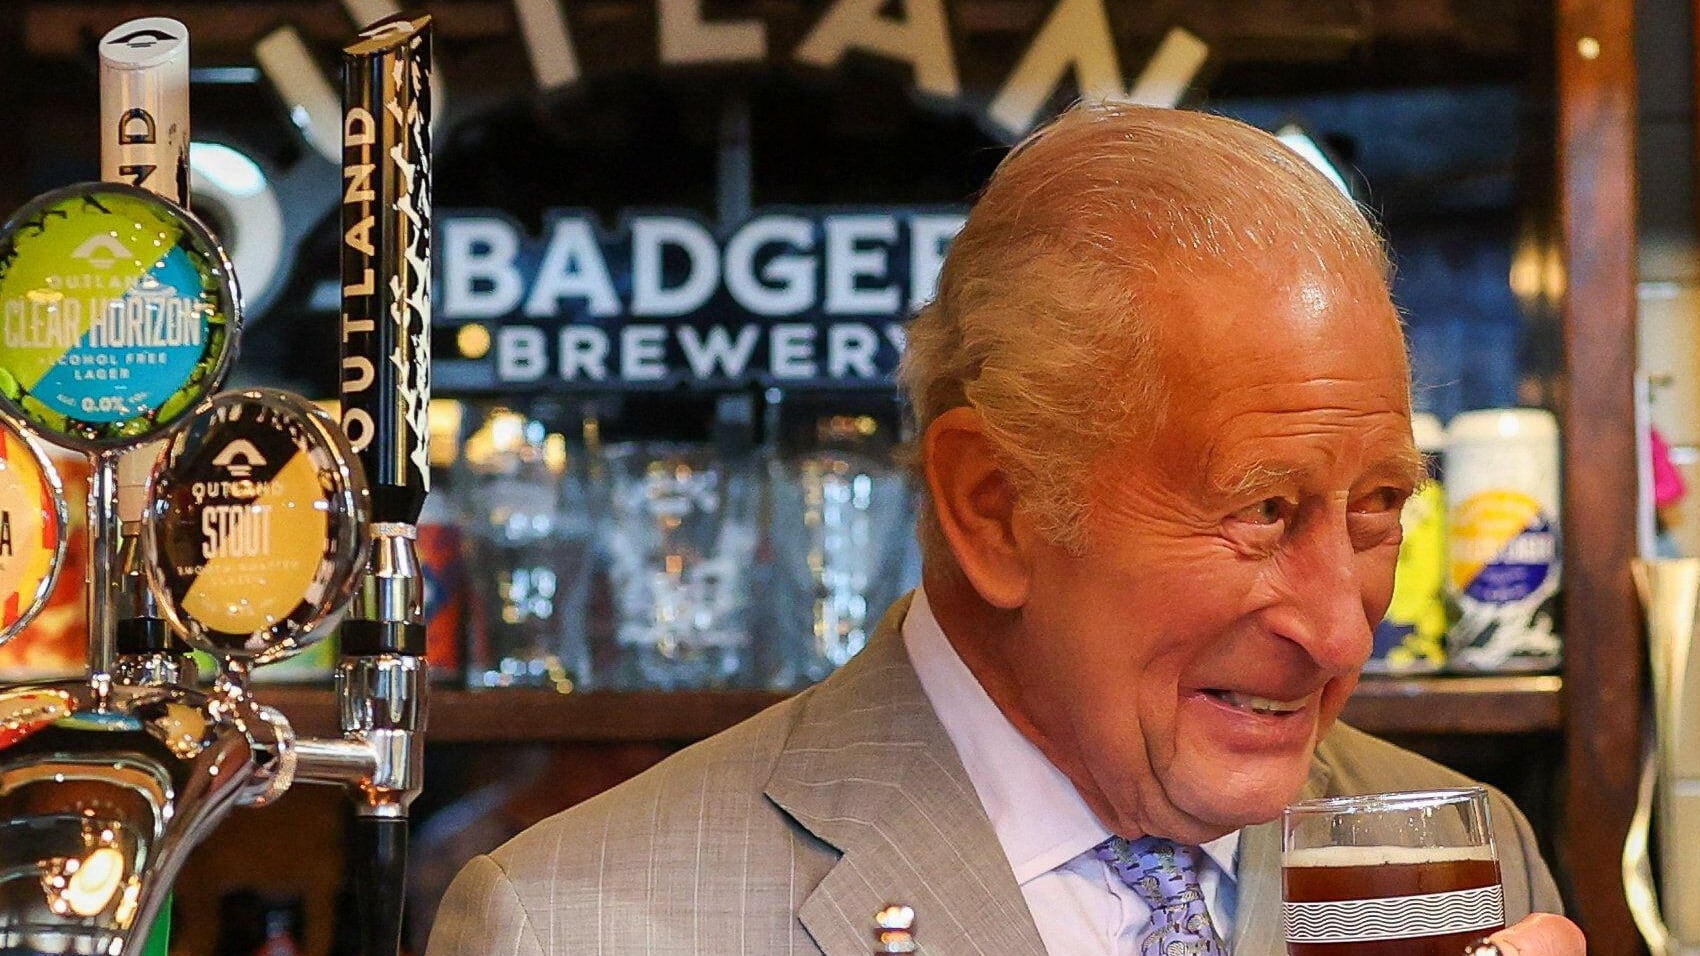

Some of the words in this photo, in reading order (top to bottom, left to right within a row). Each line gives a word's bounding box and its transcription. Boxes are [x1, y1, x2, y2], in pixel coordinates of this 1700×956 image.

[342, 106, 376, 452] OUTLAND
[3, 298, 82, 348] CLEAR
[88, 297, 202, 348] HORIZON
[74, 367, 130, 380] LAGER
[125, 351, 168, 364] FREE
[501, 325, 908, 382] BREWER
[201, 504, 272, 559] STOUT
